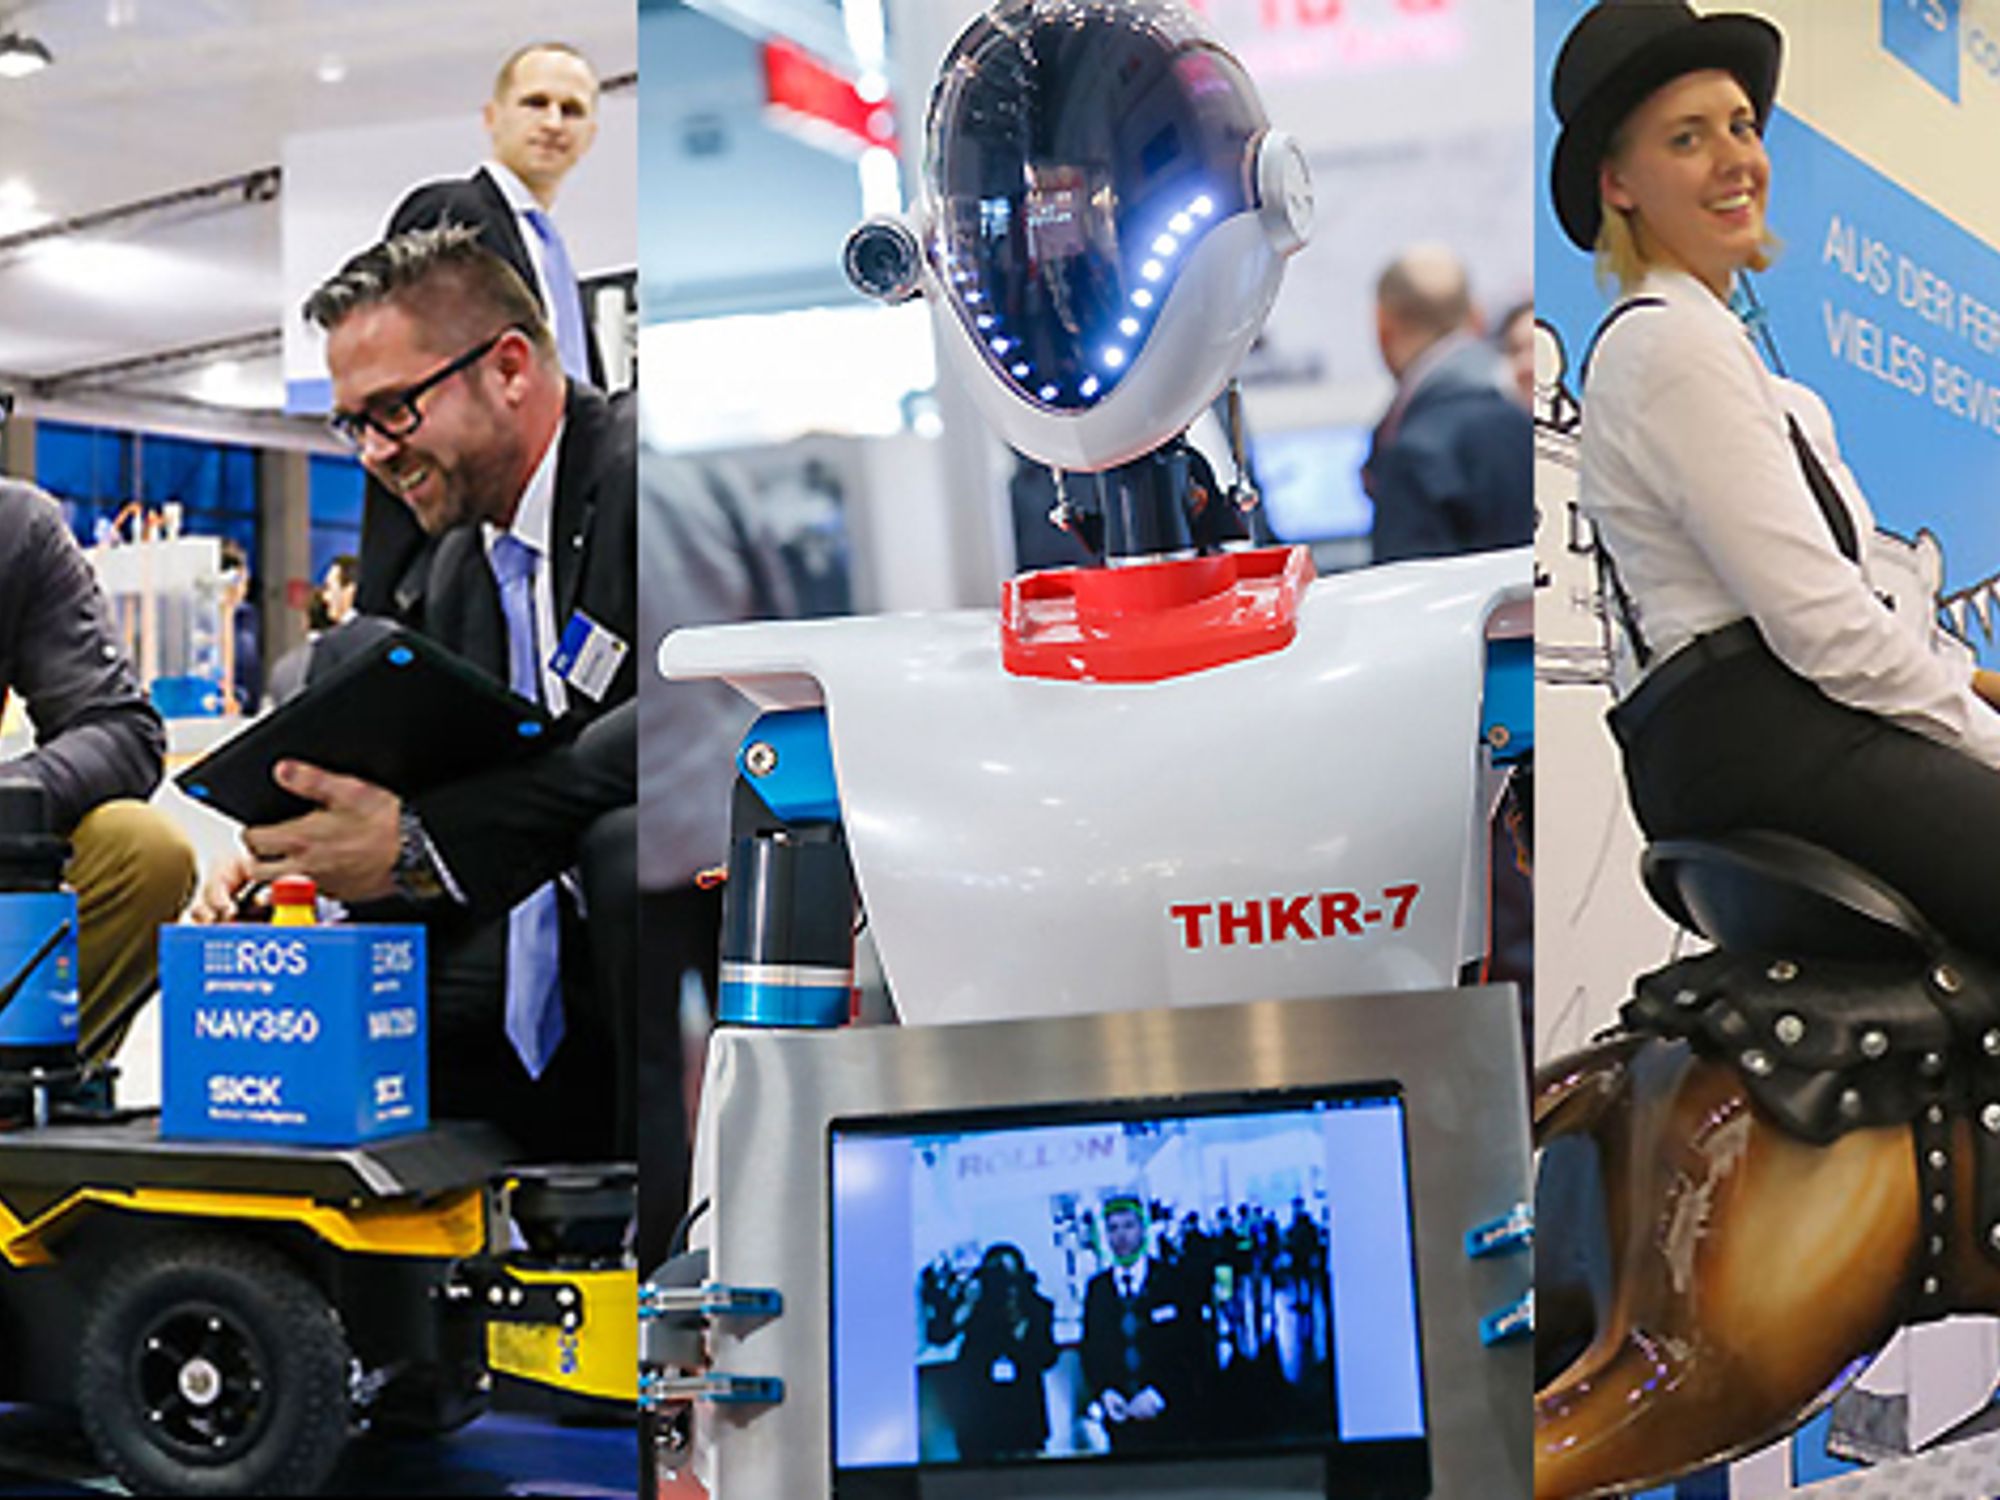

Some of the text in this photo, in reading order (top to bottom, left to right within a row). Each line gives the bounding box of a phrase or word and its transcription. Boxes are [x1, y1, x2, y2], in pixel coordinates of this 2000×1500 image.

[1823, 215, 1891, 295] AUS
[1898, 255, 1954, 332] DER
[1823, 299, 1926, 396] VIELES
[1170, 884, 1420, 949] THKR-7
[237, 940, 307, 975] ROS
[195, 1008, 318, 1042] NAV350
[208, 1075, 283, 1106] SICK
